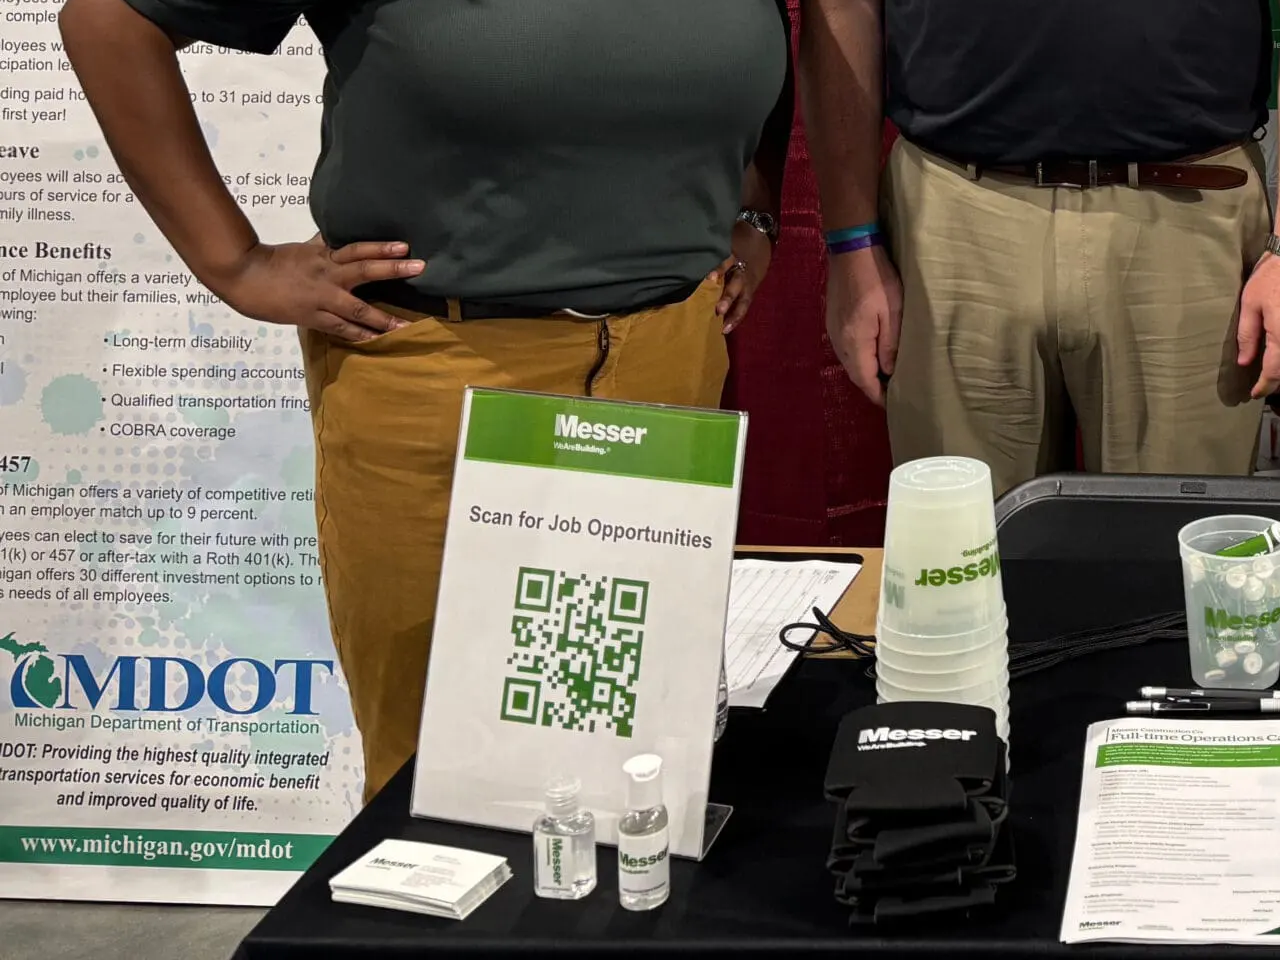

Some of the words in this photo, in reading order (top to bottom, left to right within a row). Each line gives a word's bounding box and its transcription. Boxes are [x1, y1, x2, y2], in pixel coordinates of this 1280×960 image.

[2, 108, 27, 121] first
[31, 109, 66, 123] year!
[35, 242, 112, 260] Benefits
[2, 268, 16, 281] of
[20, 268, 82, 286] Michigan
[86, 270, 126, 285] offers
[130, 273, 140, 284] a
[144, 271, 194, 288] variety
[113, 334, 186, 350] Long-term
[112, 365, 167, 378] Flexible
[171, 366, 236, 381] spending
[241, 368, 305, 379] accounts
[111, 395, 173, 408] Qualified
[179, 396, 276, 411] transportation
[110, 424, 167, 437] COBRA
[170, 427, 236, 440] coverage
[554, 413, 647, 445] Messer
[9, 505, 26, 516] an
[30, 504, 96, 520] employer
[99, 505, 142, 518] match
[147, 508, 165, 522] up
[169, 506, 183, 519] to
[187, 506, 196, 519] 9
[200, 507, 257, 522] percent.
[469, 505, 513, 528] Scan
[518, 510, 544, 529] for
[548, 514, 582, 534] Job
[587, 519, 713, 549] Opportunities
[56, 654, 333, 715] MDOT
[14, 712, 85, 731] Michigan
[90, 714, 182, 732] Department
[186, 717, 202, 731] of
[205, 717, 319, 736] Transportation
[858, 726, 977, 744] Messer
[1111, 732, 1178, 741] Full-time
[1181, 733, 1264, 743] Operations
[41, 743, 112, 764] Providing
[116, 745, 139, 761] the
[143, 746, 198, 765] highest
[201, 748, 251, 768] quality
[254, 749, 330, 769] integrated
[104, 769, 165, 785] services
[169, 770, 191, 786] for
[193, 772, 265, 788] economic
[268, 772, 320, 789] benefit
[56, 790, 85, 806] and
[88, 791, 157, 810] improved
[160, 794, 210, 813] quality
[214, 795, 230, 810] of
[232, 795, 258, 811] life.
[20, 834, 294, 861] www.michigan.gov/mdot
[372, 857, 418, 870] Messer
[551, 838, 562, 886] Messer
